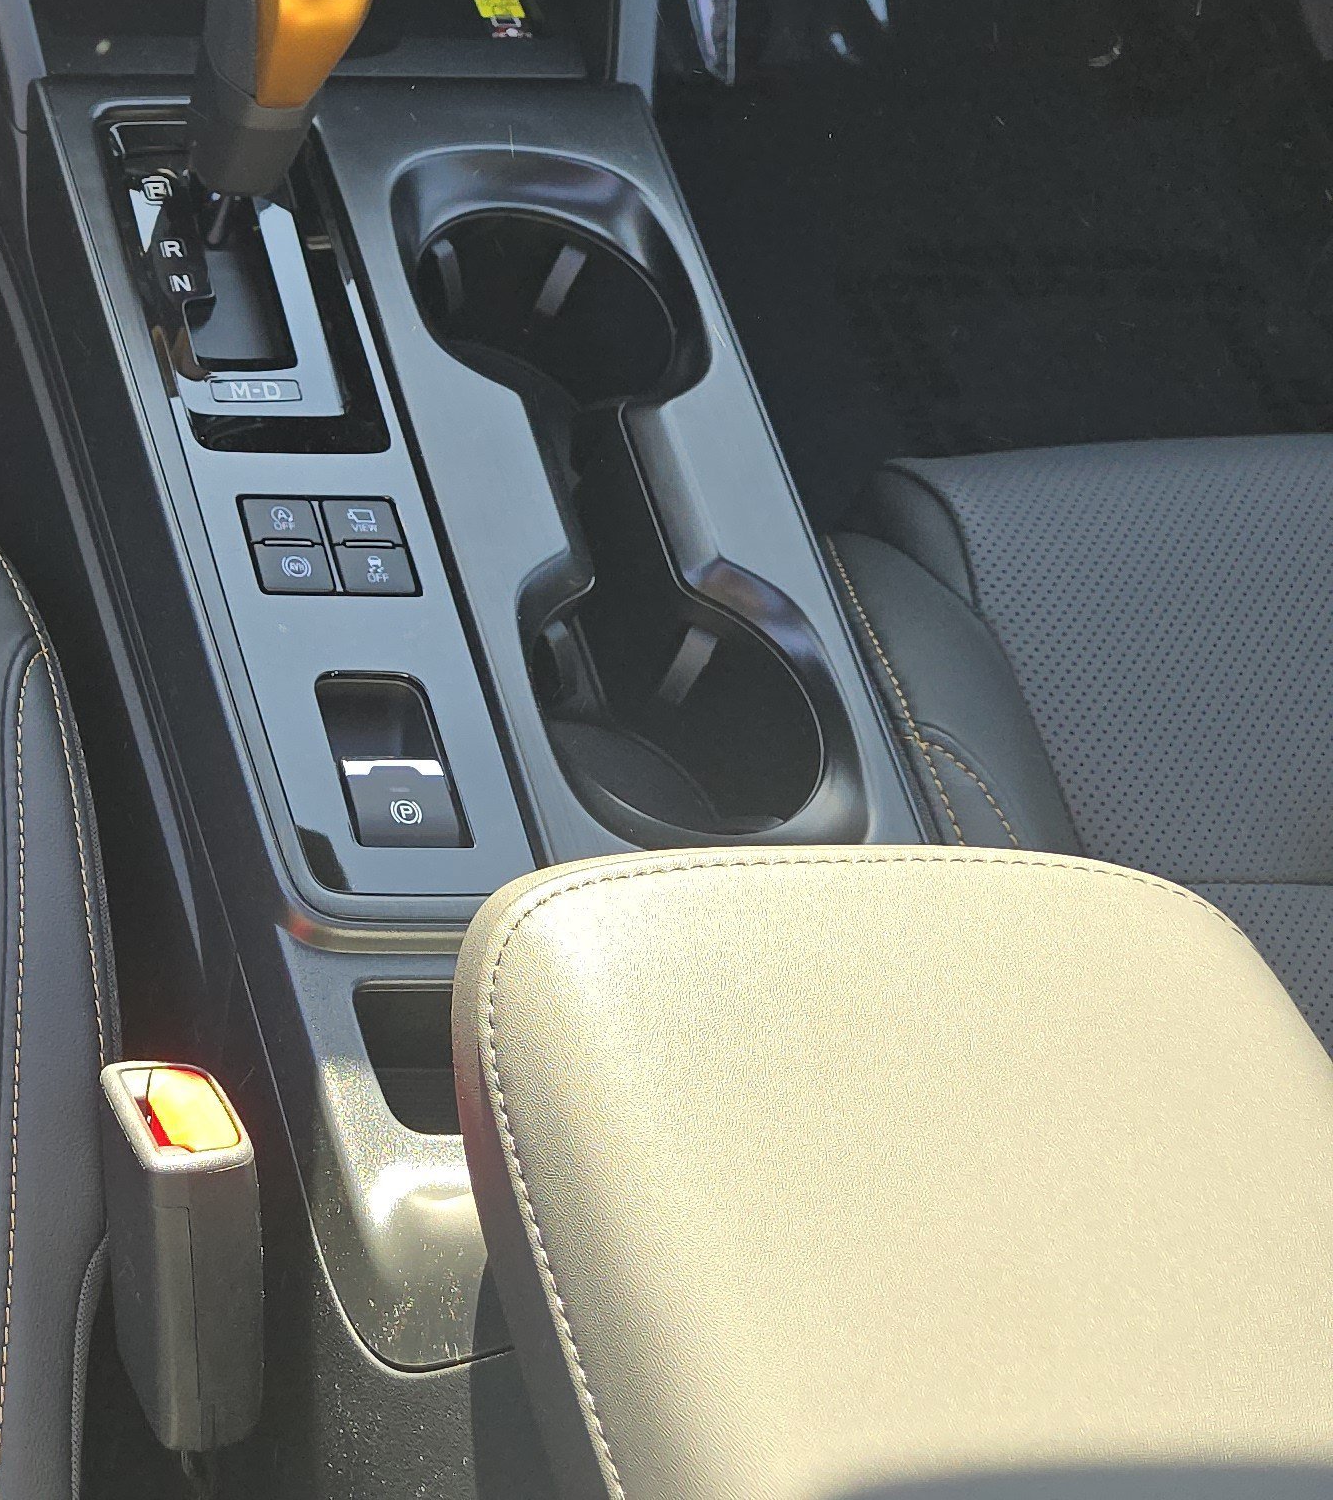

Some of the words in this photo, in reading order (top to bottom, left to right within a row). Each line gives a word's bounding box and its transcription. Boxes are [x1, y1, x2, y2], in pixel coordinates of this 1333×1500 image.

[162, 240, 184, 258] R
[171, 274, 193, 293] N
[273, 521, 295, 531] OFF
[350, 523, 378, 533] VIEW
[367, 572, 389, 583] OFF
